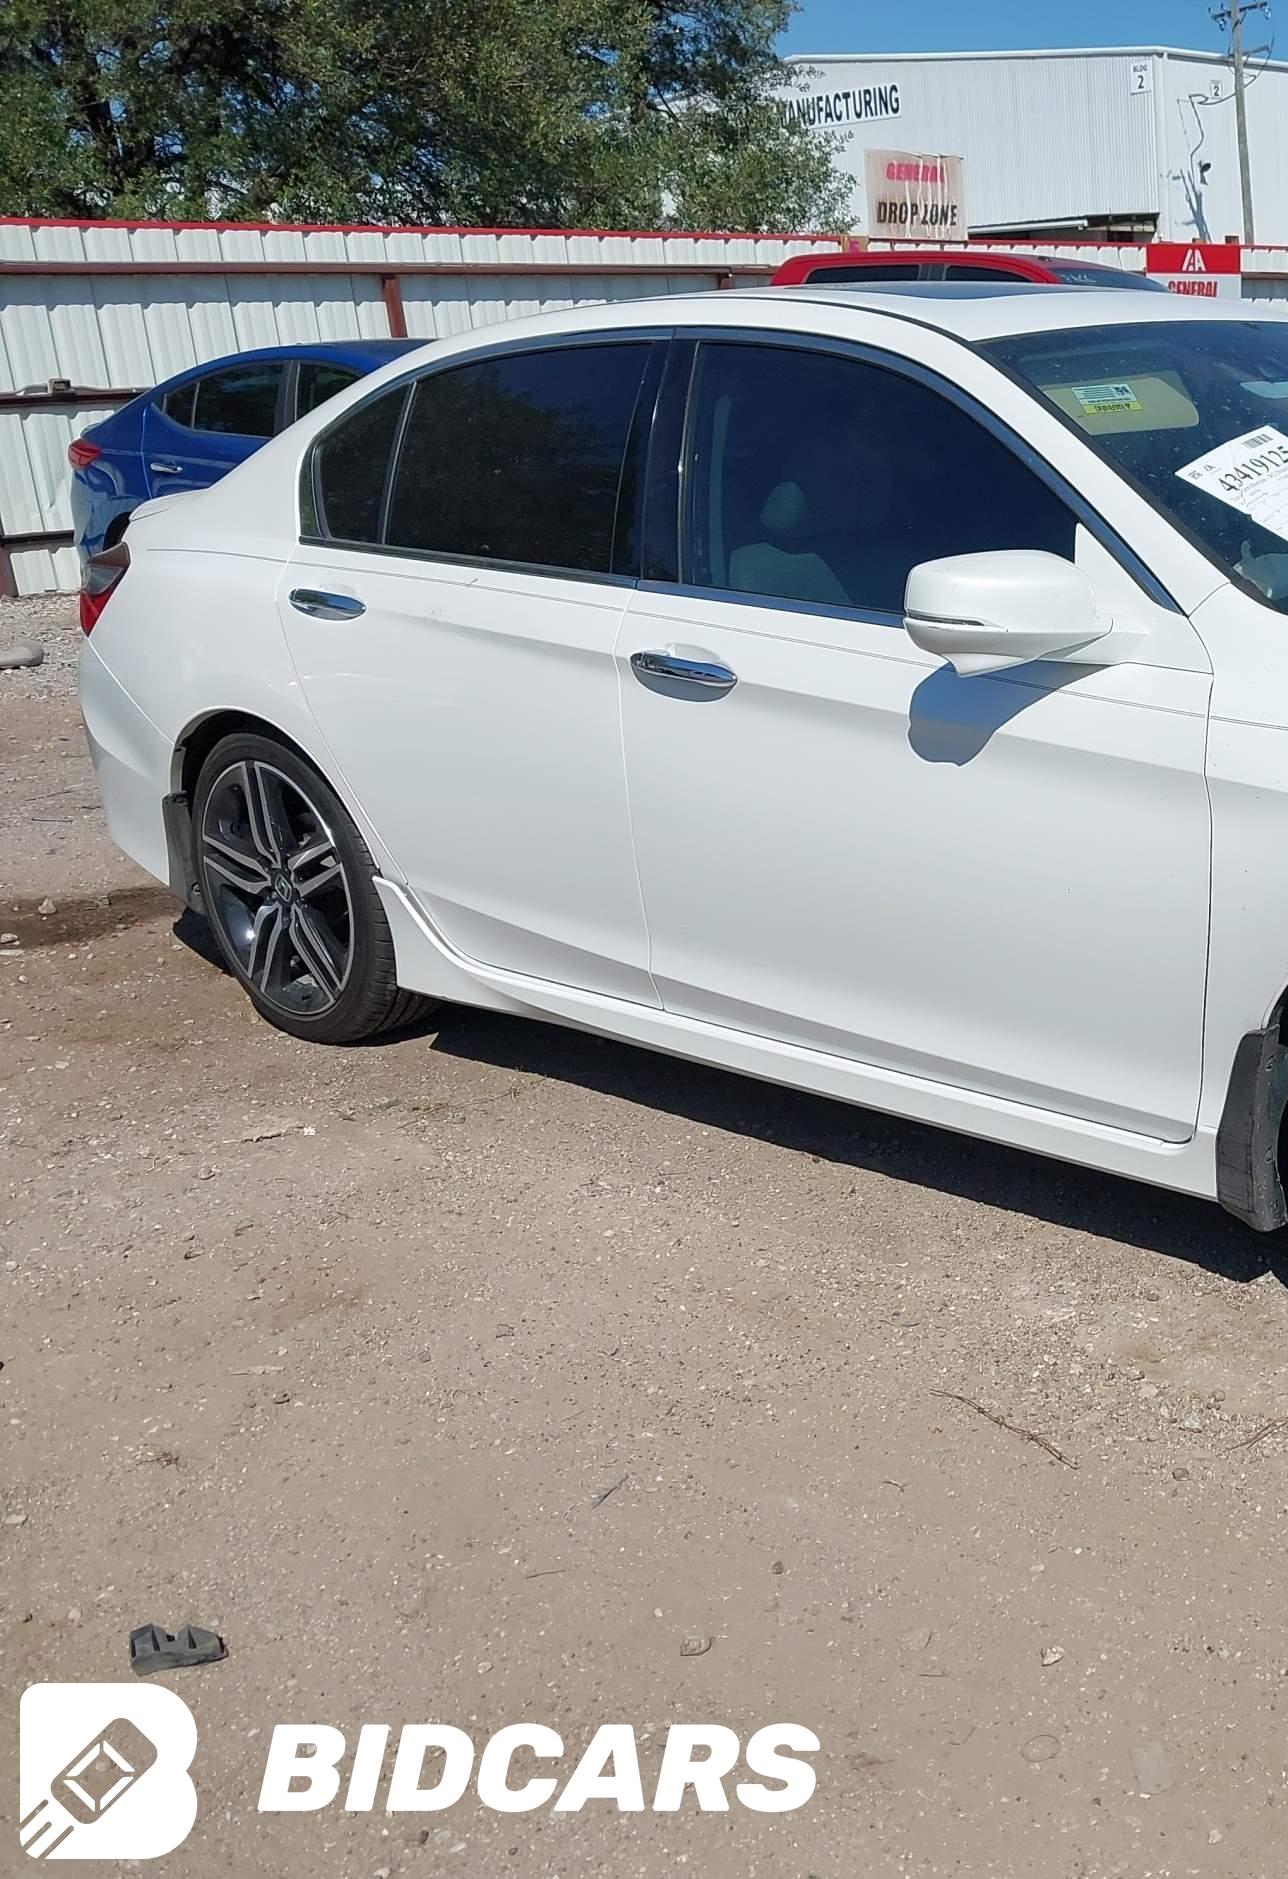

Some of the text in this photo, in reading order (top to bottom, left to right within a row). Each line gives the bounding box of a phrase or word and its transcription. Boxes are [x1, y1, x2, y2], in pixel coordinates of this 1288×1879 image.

[1132, 64, 1148, 73] BLDG
[1137, 74, 1145, 90] 2
[876, 201, 919, 225] DROP
